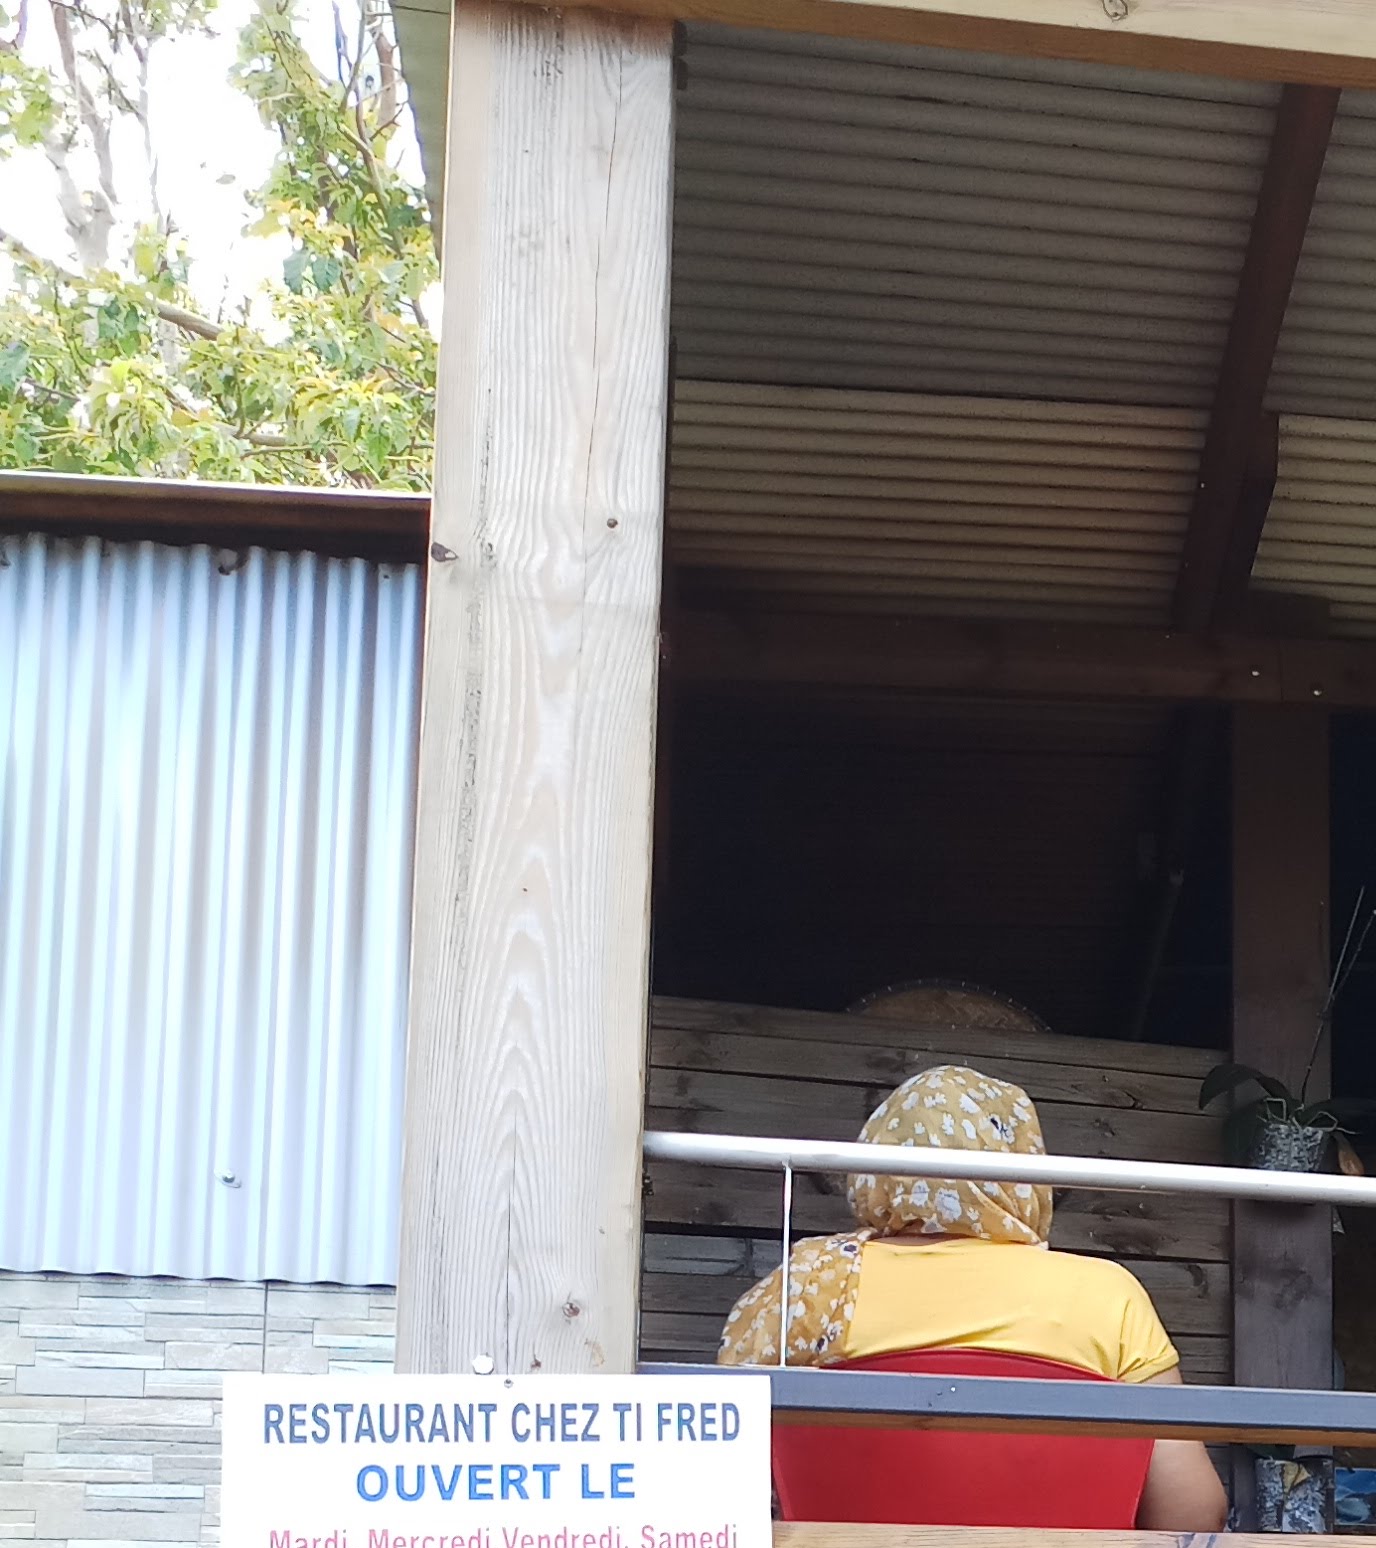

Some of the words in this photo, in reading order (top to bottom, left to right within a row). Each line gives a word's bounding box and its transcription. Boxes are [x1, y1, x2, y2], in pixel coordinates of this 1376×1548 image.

[263, 1402, 498, 1445] RESTAURANT
[510, 1402, 601, 1444] CHEZ
[612, 1402, 642, 1442] TI
[656, 1402, 741, 1442] FRED
[355, 1463, 561, 1503] OUVERT
[580, 1462, 636, 1500] LE
